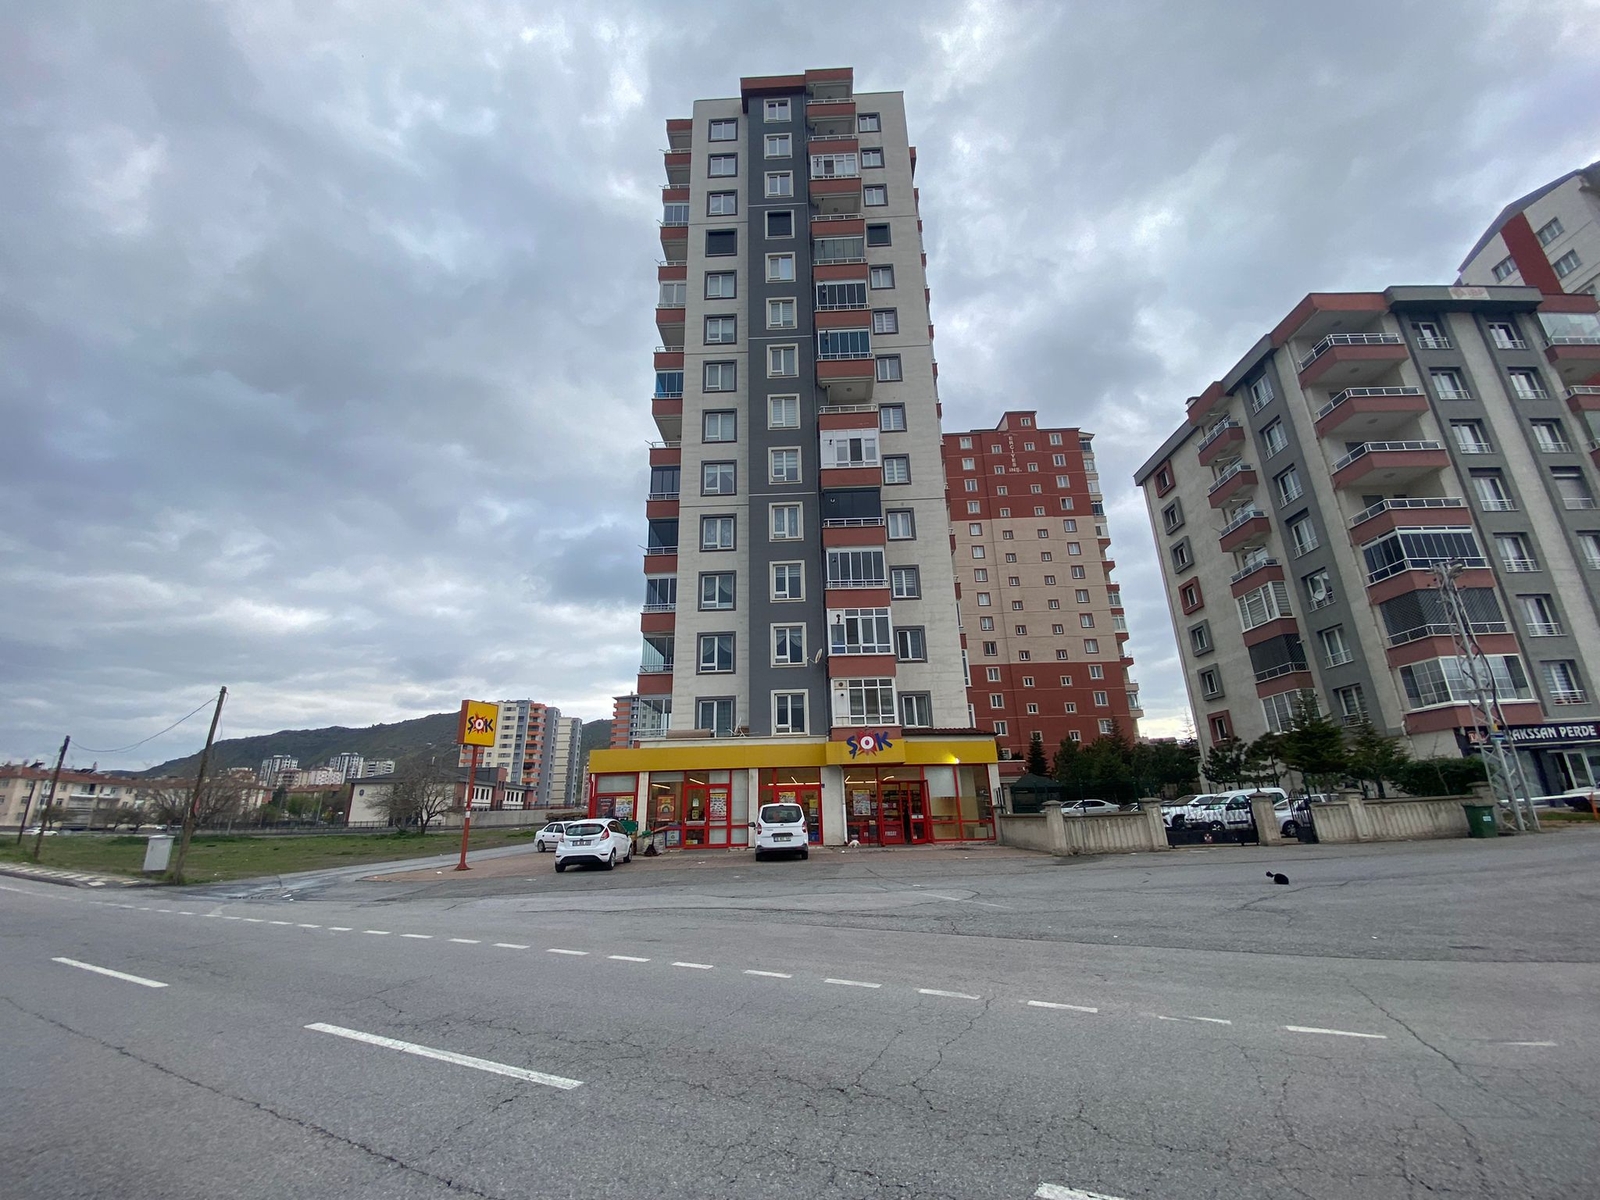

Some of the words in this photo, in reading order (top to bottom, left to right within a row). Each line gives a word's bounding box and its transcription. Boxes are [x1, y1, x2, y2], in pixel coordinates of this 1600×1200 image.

[467, 716, 494, 734] ŞOK
[1559, 725, 1597, 738] PERDE
[846, 731, 893, 759] ŞOK
